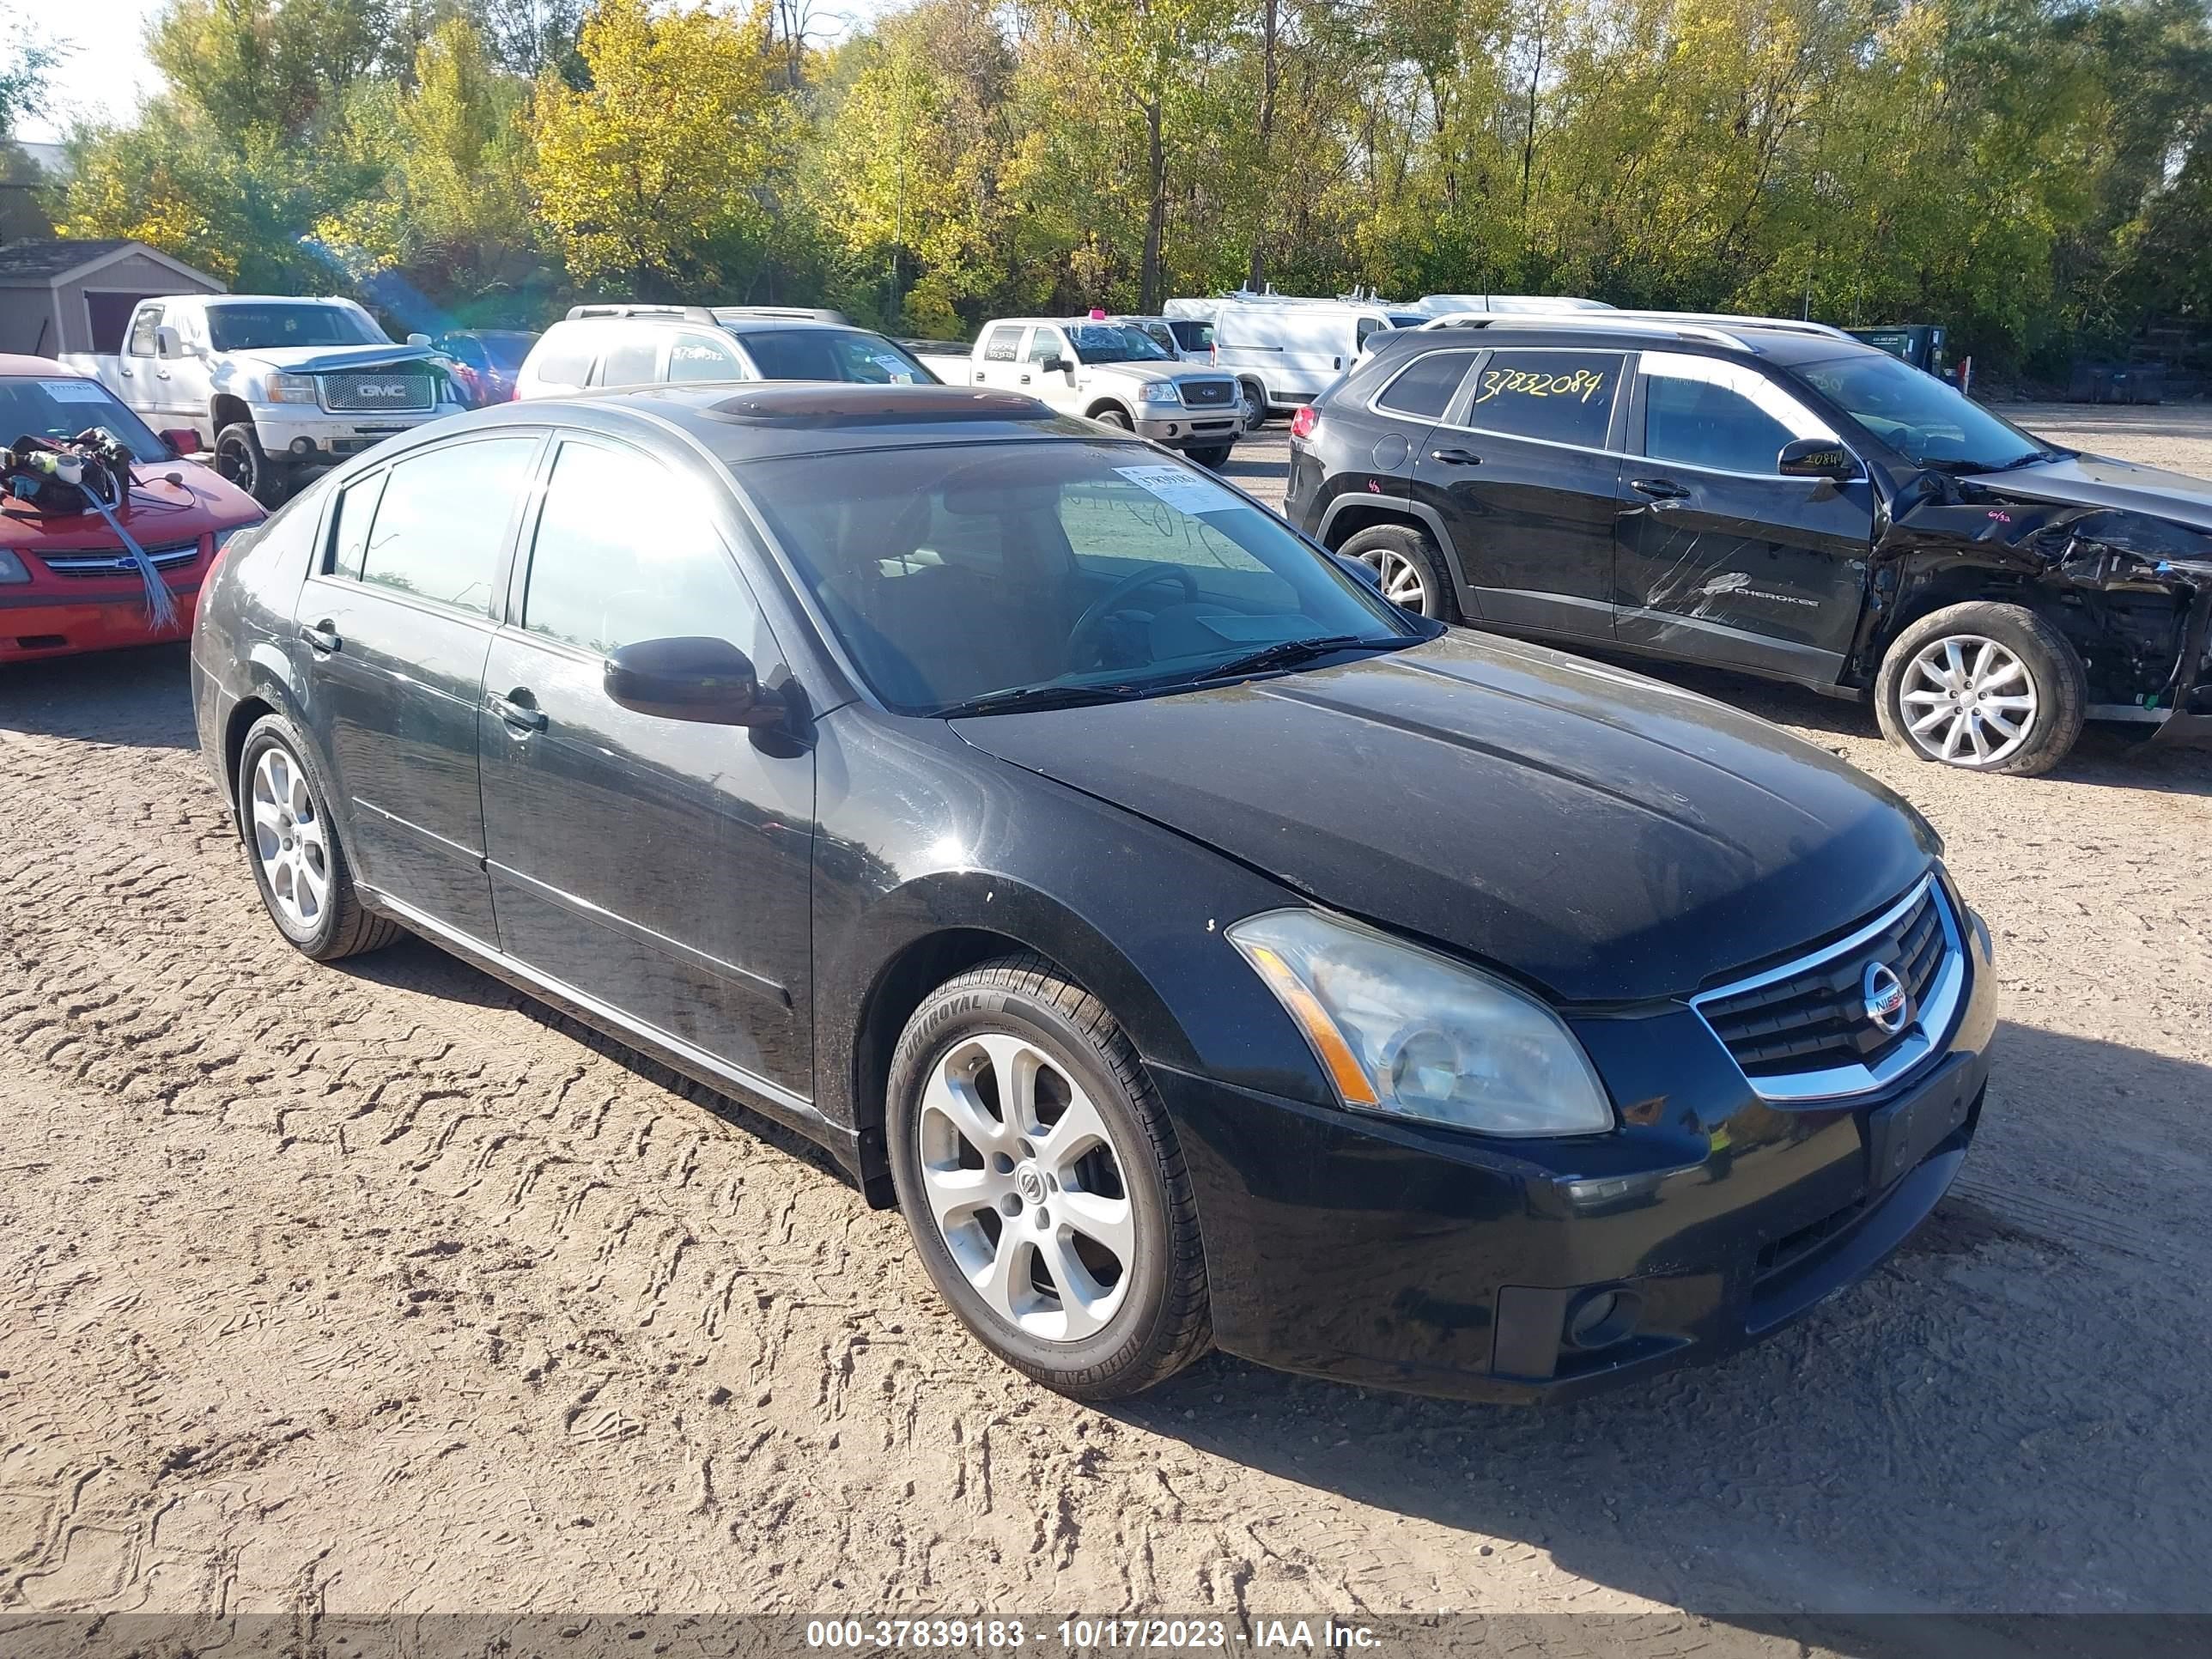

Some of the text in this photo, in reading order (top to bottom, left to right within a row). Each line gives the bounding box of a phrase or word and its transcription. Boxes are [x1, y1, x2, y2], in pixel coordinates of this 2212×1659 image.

[358, 385, 406, 397] GMC
[1475, 368, 1603, 404] 37832084
[1734, 587, 1820, 607] CHEROKEE
[904, 994, 982, 1062] UNIROYAL
